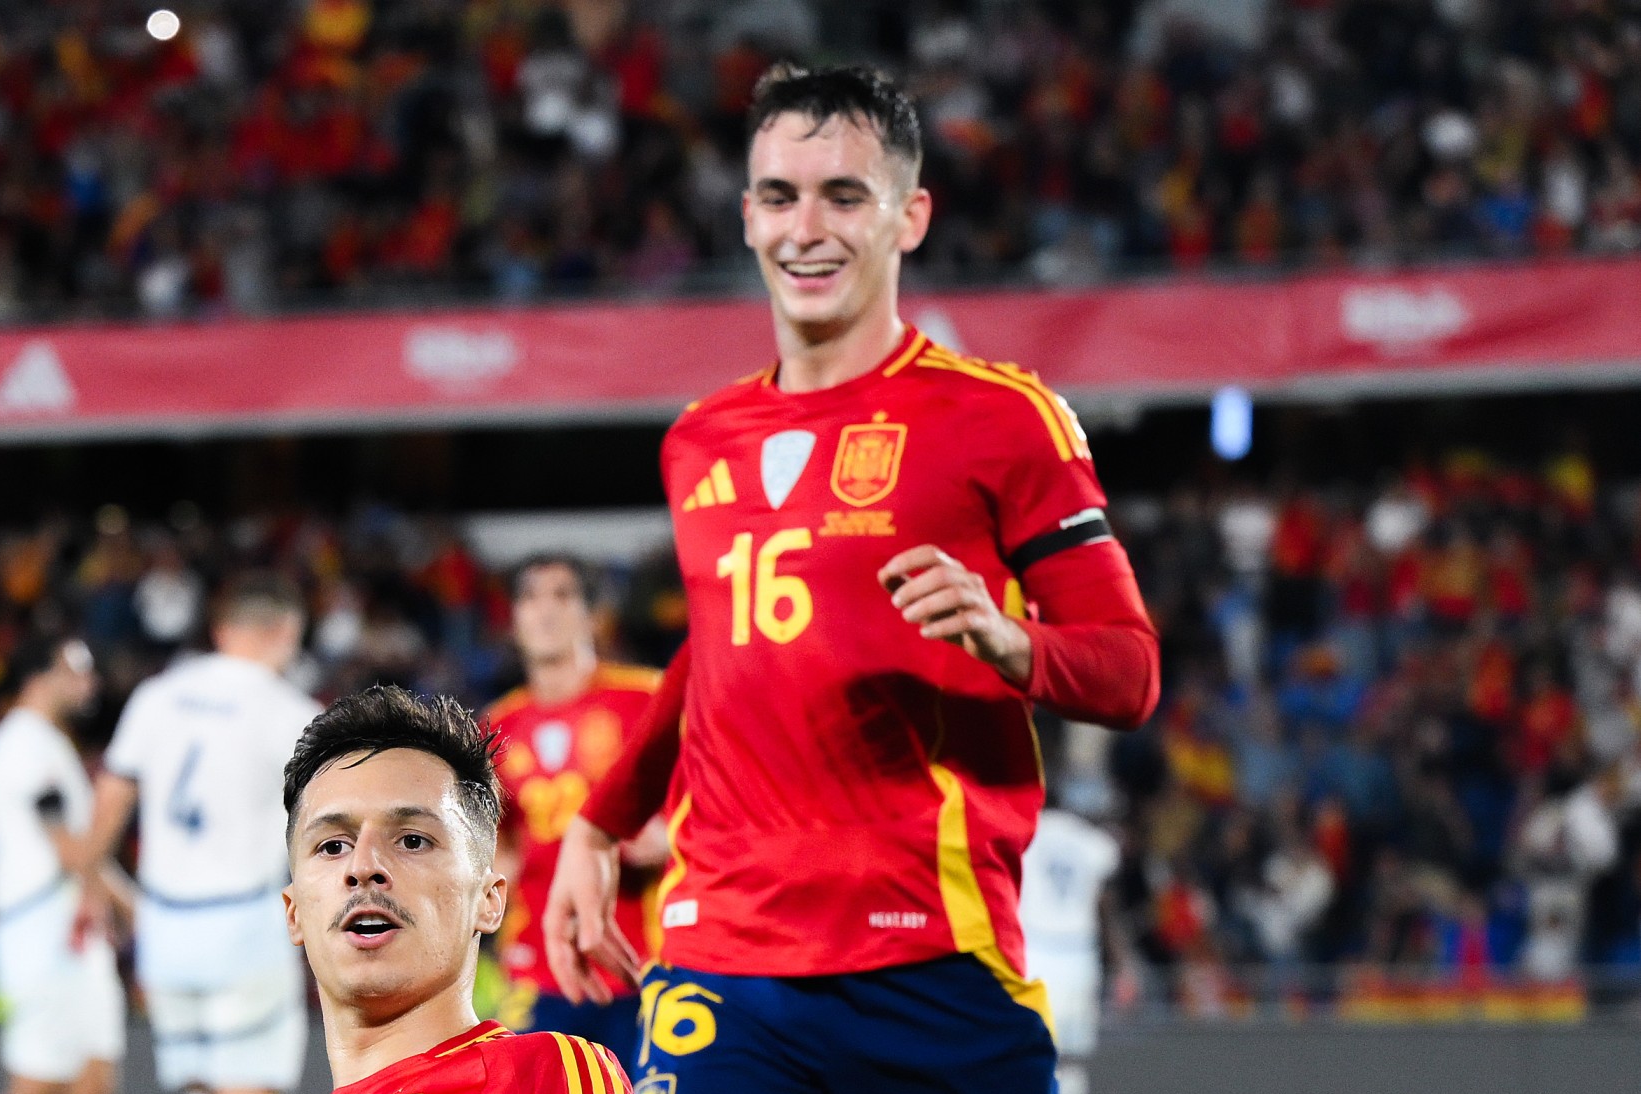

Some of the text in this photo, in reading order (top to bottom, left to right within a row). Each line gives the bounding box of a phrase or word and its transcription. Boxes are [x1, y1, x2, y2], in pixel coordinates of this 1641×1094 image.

[716, 527, 813, 647] 16
[167, 741, 209, 838] 4
[637, 979, 725, 1067] 16
